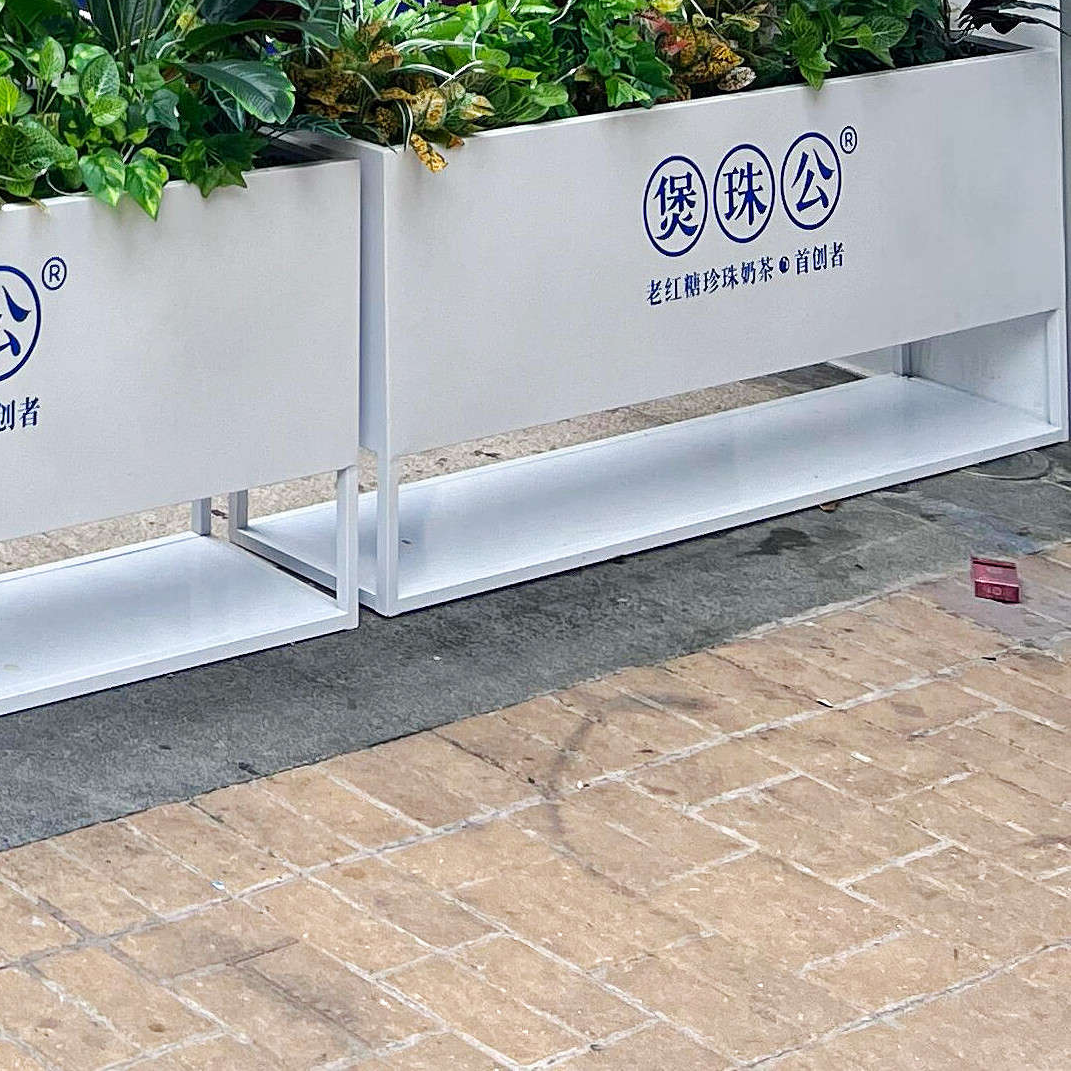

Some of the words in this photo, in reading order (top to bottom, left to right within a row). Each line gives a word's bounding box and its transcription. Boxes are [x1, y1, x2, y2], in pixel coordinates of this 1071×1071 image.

[646, 136, 840, 253] 煲珠公
[646, 256, 774, 306] 老红糖珍珠奶茶
[794, 241, 845, 275] 首创者
